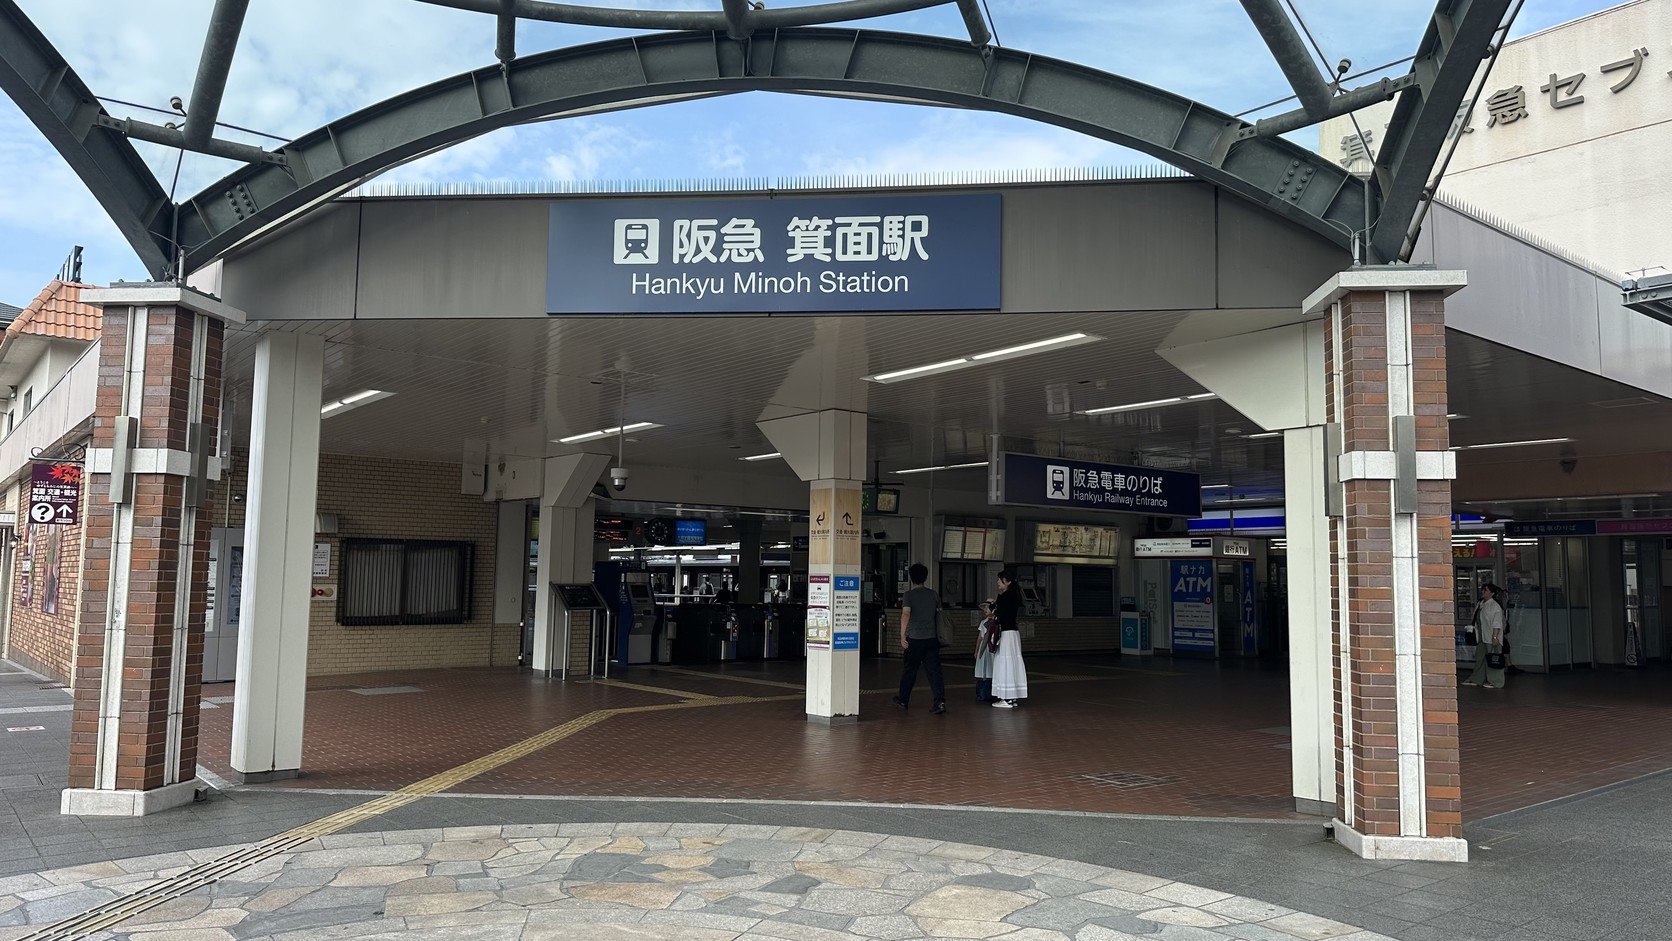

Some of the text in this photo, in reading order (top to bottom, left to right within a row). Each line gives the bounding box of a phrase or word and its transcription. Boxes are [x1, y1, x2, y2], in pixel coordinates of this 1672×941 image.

[672, 215, 929, 264] 阪急 箕面駅
[631, 270, 909, 299] Hankyu Minoh Station
[1073, 468, 1163, 495] 阪急電車のりば
[31, 494, 52, 502] 案内所
[32, 487, 46, 495] 箕面
[1073, 490, 1168, 508] Hankyu Railway Entrance
[1179, 564, 1205, 575] 駅ナカ
[1173, 576, 1212, 593] ATM
[1244, 589, 1254, 638] ATM
